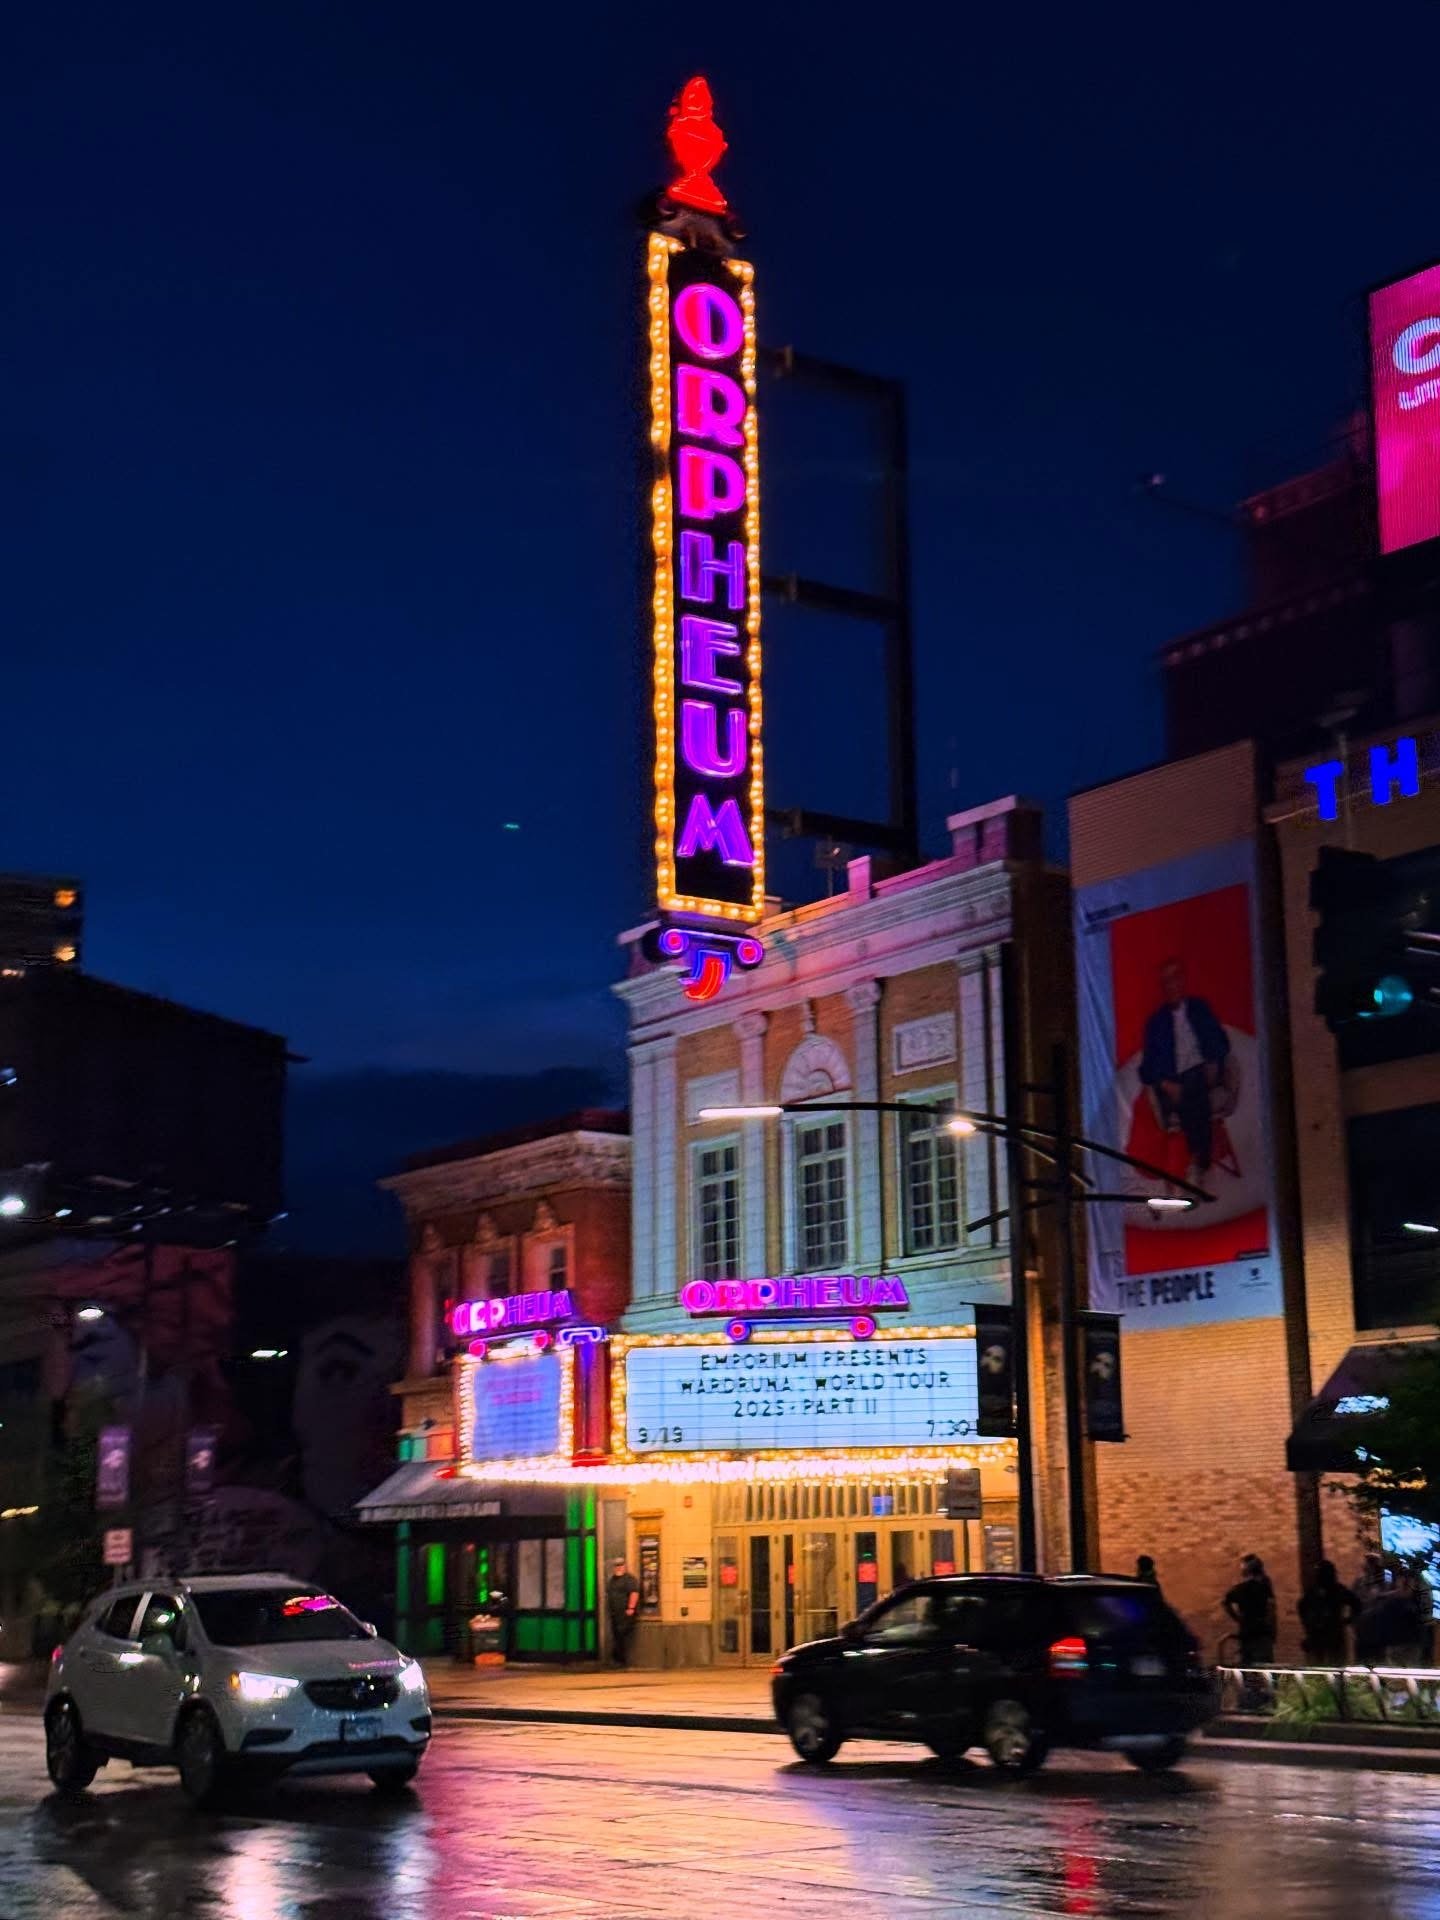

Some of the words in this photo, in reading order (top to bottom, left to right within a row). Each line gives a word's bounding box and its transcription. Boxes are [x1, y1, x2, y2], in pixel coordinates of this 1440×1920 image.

[674, 282, 755, 867] ORPHEUM
[681, 1275, 909, 1312] ORPHEUM
[1117, 1279, 1147, 1307] THE
[1151, 1270, 1216, 1305] PEOPLE
[701, 1352, 807, 1371] EMPORIUM
[824, 1347, 926, 1367] PRESENTS
[815, 1373, 885, 1391] WORLD
[894, 1370, 950, 1389] TOUR
